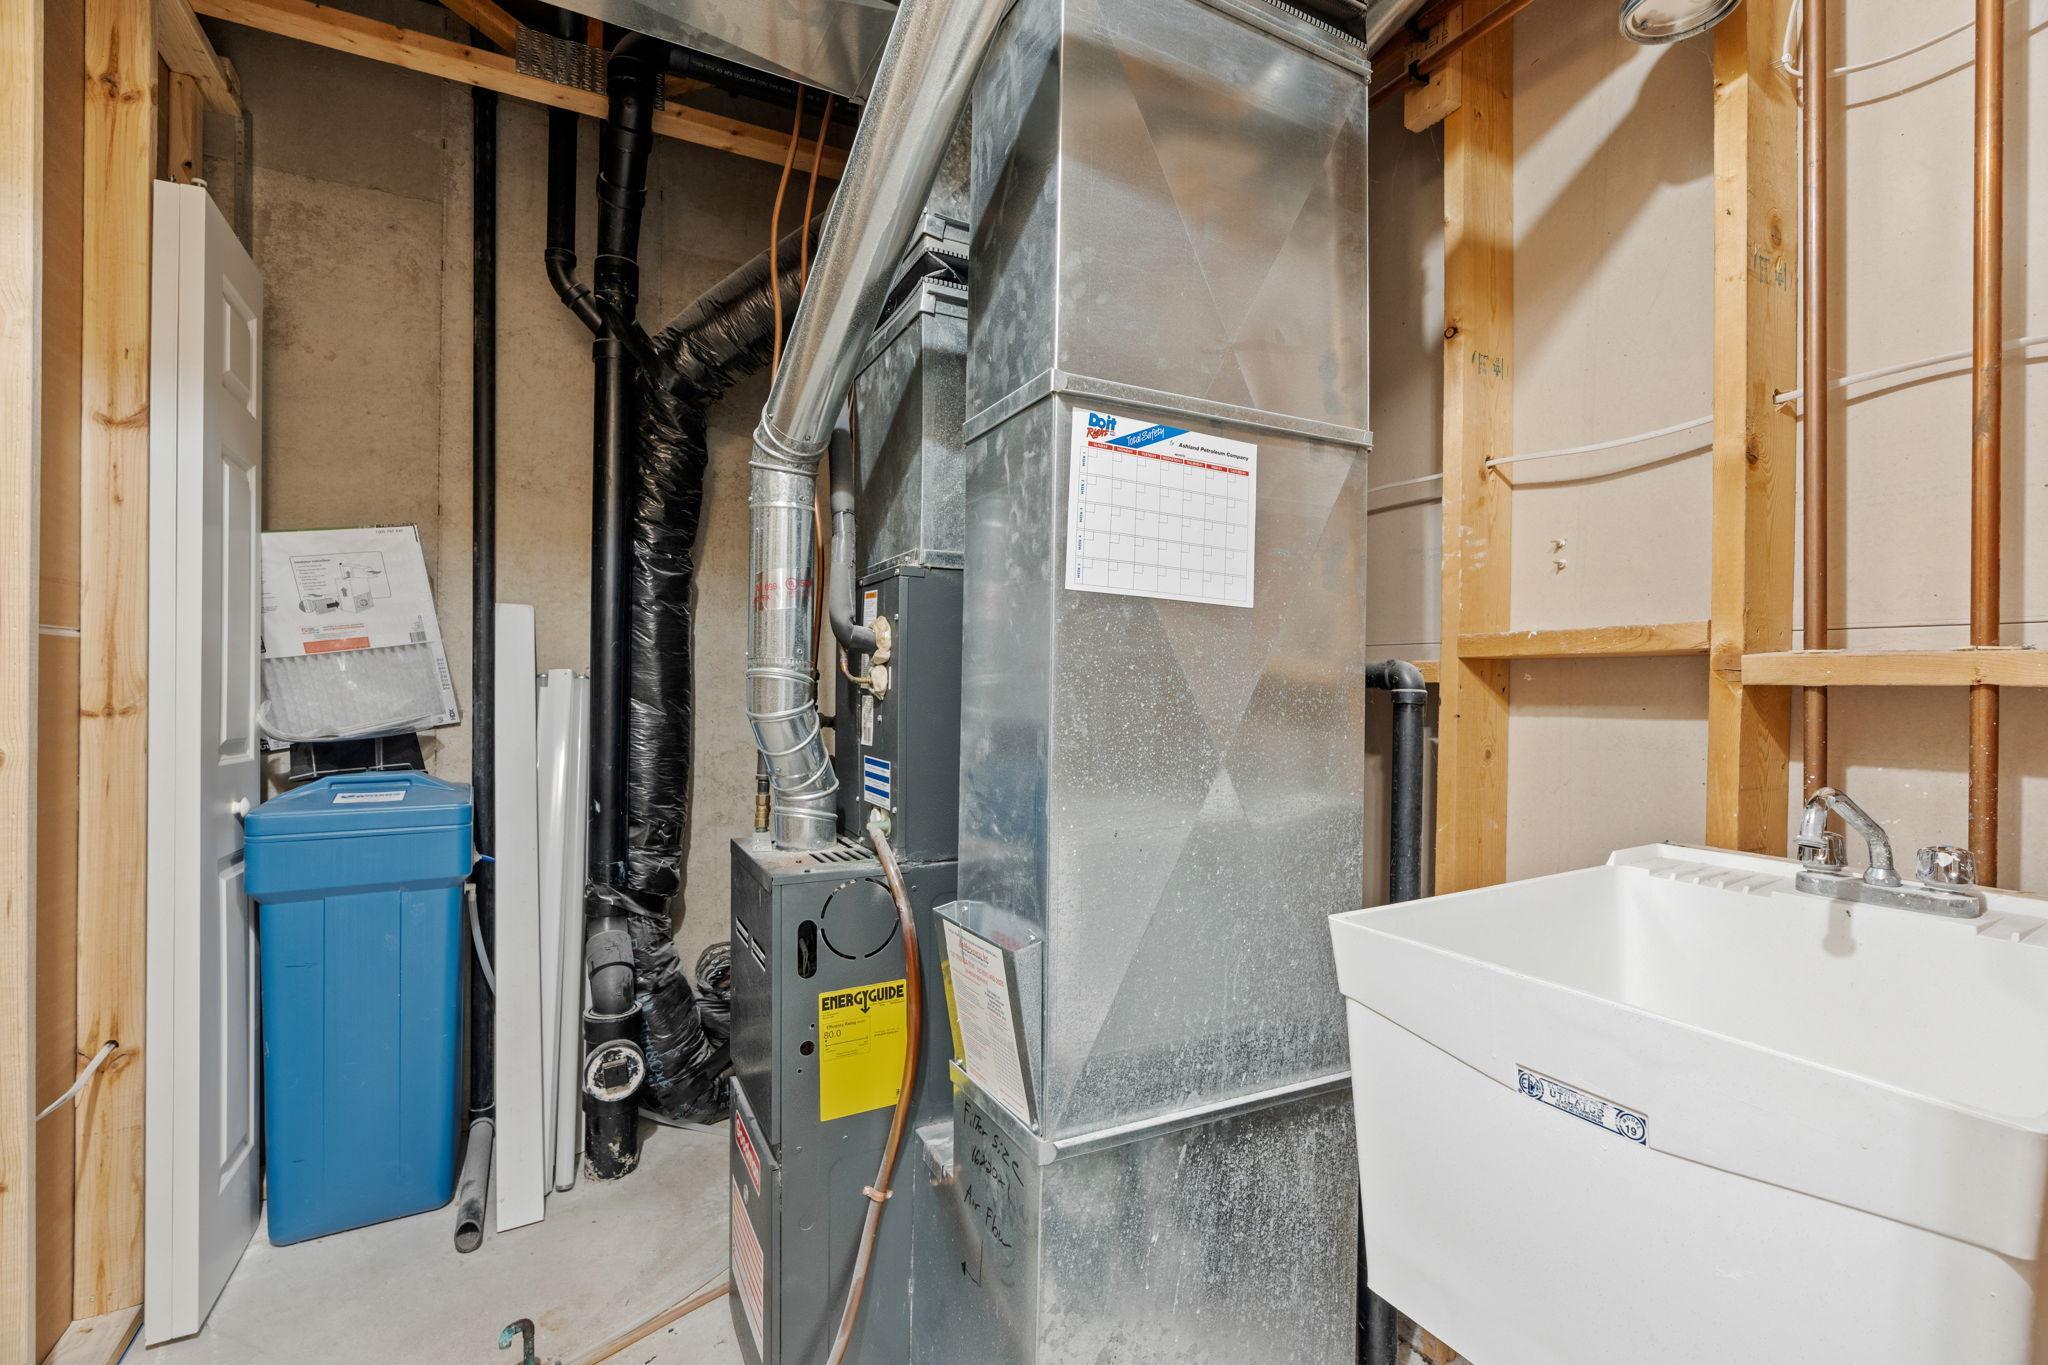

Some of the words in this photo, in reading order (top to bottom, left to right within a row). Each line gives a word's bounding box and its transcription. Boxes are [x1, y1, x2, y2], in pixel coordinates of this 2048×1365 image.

[1086, 428, 1110, 439] Right
[1127, 434, 1141, 446] Total
[1141, 427, 1165, 442] Safety
[1179, 443, 1200, 452] Ashland
[1200, 447, 1226, 456] Petroleum
[1226, 452, 1249, 461] Company
[822, 984, 904, 1011] ENERGYGUIDE
[824, 1030, 841, 1039] 80.0
[1550, 1088, 1605, 1118] UTILATUB
[1622, 1117, 1642, 1130] MODEL
[1626, 1124, 1637, 1136] 19
[963, 1100, 988, 1137] Filter
[992, 1134, 1024, 1188] Size
[964, 1184, 980, 1211] Air
[985, 1207, 1012, 1248] Flow
